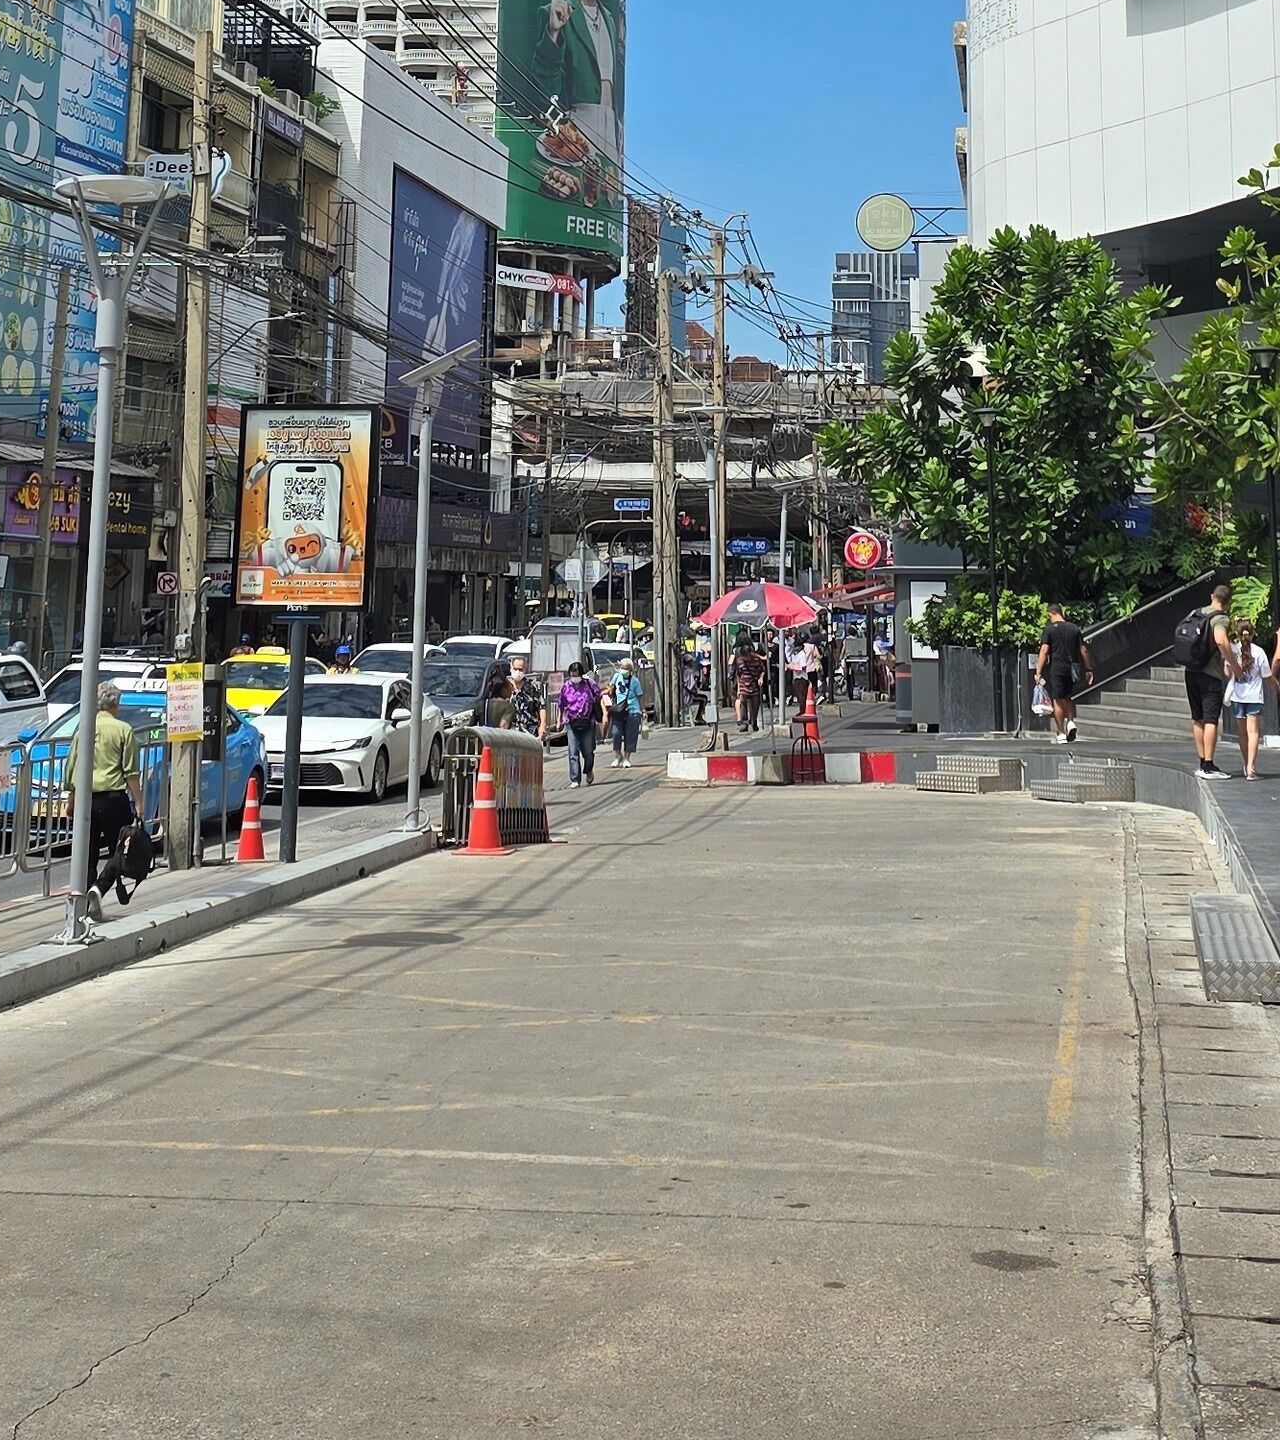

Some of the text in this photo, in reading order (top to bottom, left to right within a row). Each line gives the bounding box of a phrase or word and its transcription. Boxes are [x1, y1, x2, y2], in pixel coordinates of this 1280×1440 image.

[4, 73, 46, 167] 5
[84, 128, 95, 145] 11
[566, 215, 604, 237] FREE
[498, 270, 525, 283] CMYK
[297, 439, 332, 455] 1,100
[128, 521, 148, 535] home
[755, 540, 766, 550] 50
